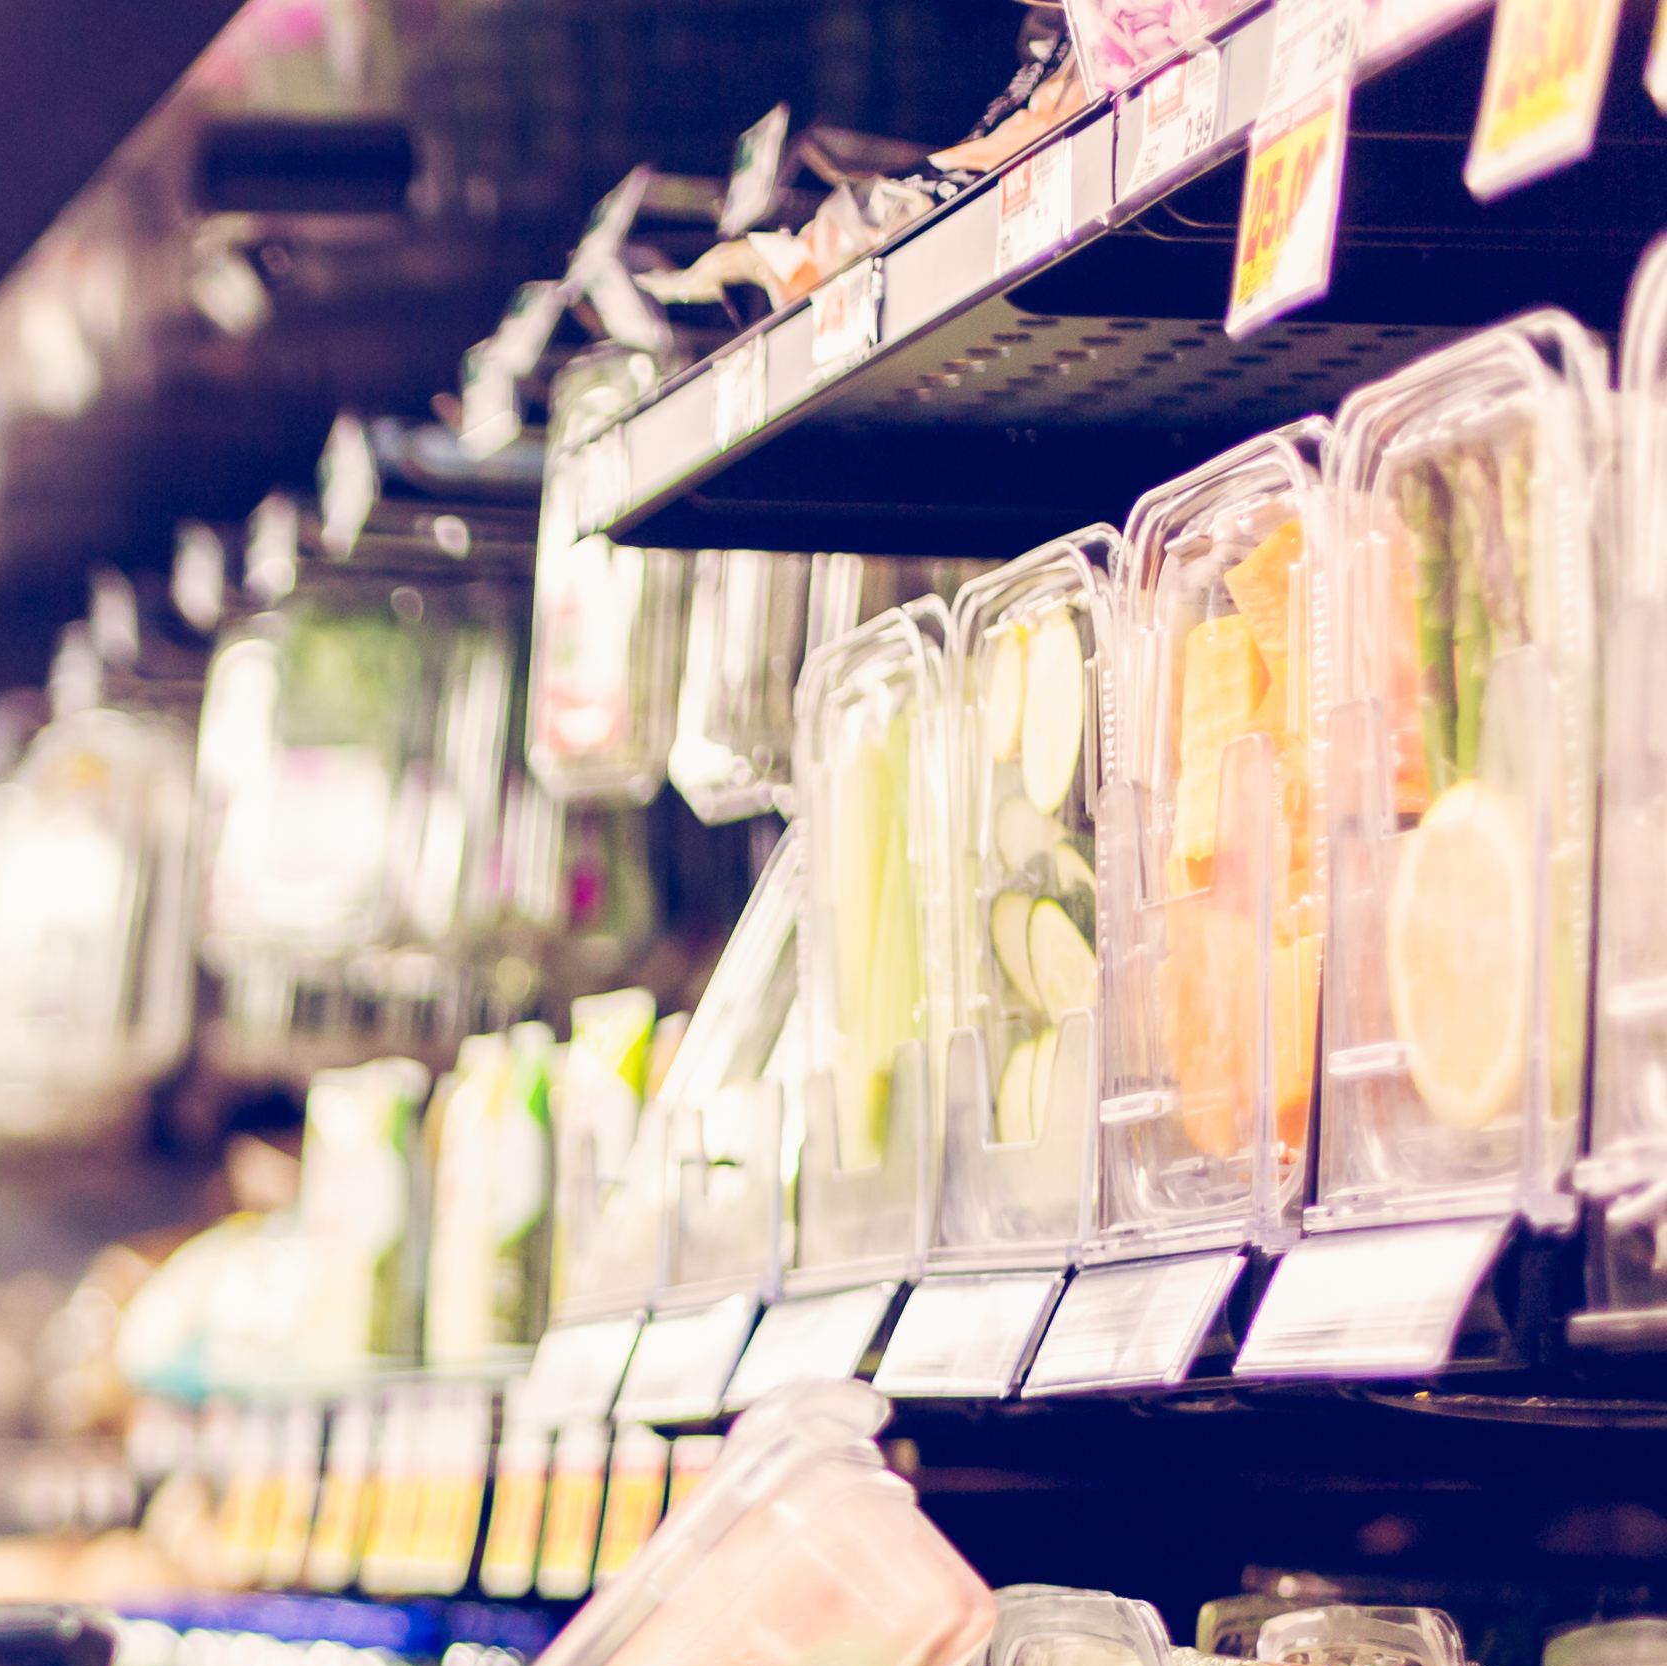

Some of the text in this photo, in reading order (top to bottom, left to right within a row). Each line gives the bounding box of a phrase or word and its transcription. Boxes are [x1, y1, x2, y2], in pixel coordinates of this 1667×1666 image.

[1313, 15, 1349, 72] 2.99
[1182, 104, 1214, 159] 2.99
[1311, 570, 1329, 722] CORNER
